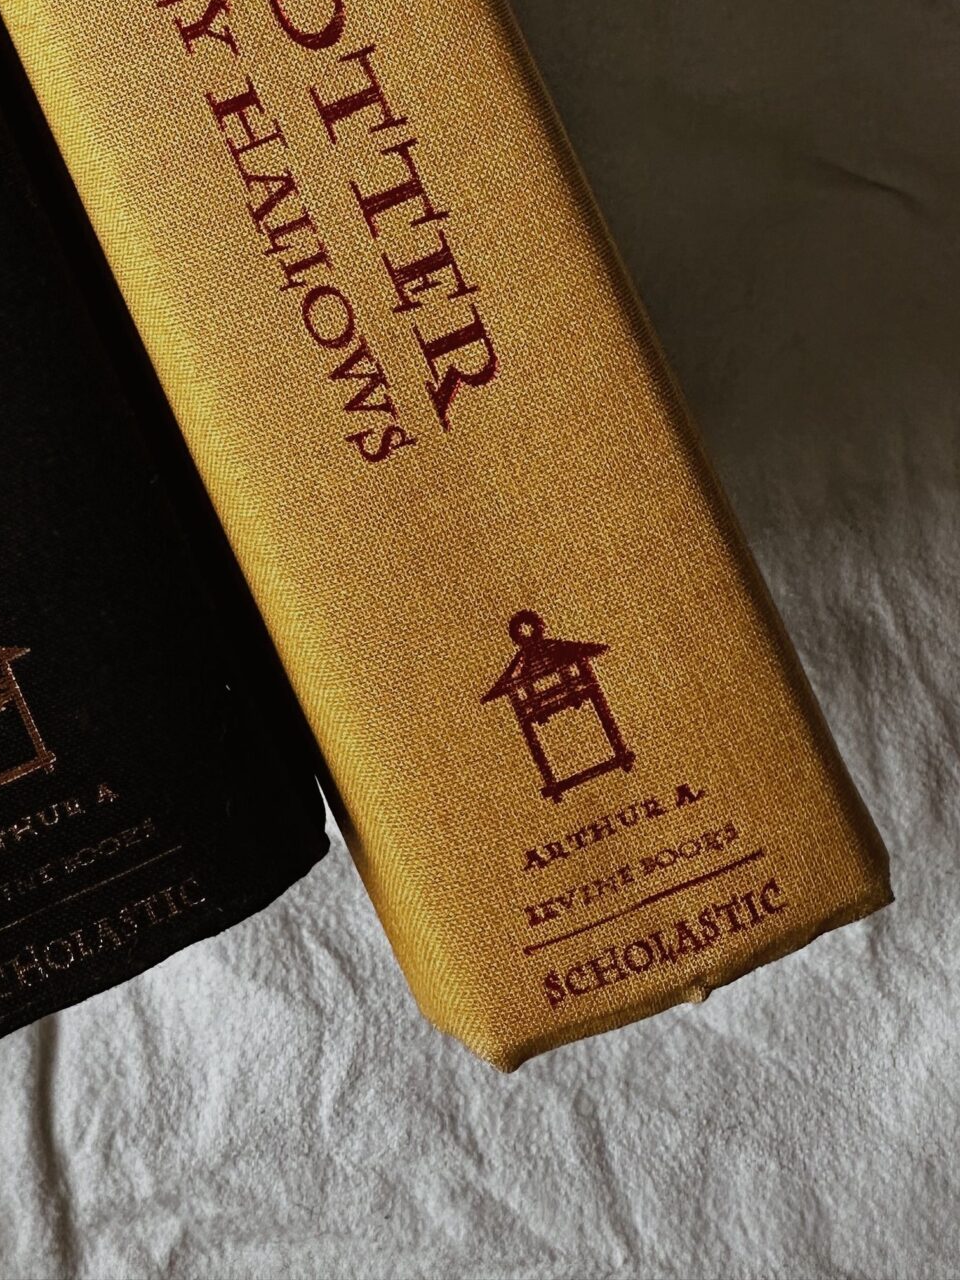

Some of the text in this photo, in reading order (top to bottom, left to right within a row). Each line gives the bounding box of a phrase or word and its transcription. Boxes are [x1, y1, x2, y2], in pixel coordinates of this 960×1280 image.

[206, 76, 417, 463] HALLOWS
[524, 797, 667, 871] ARTHUR
[524, 823, 739, 926] LEVINE BOOKS
[543, 877, 788, 1008] SCHOLASTIC
